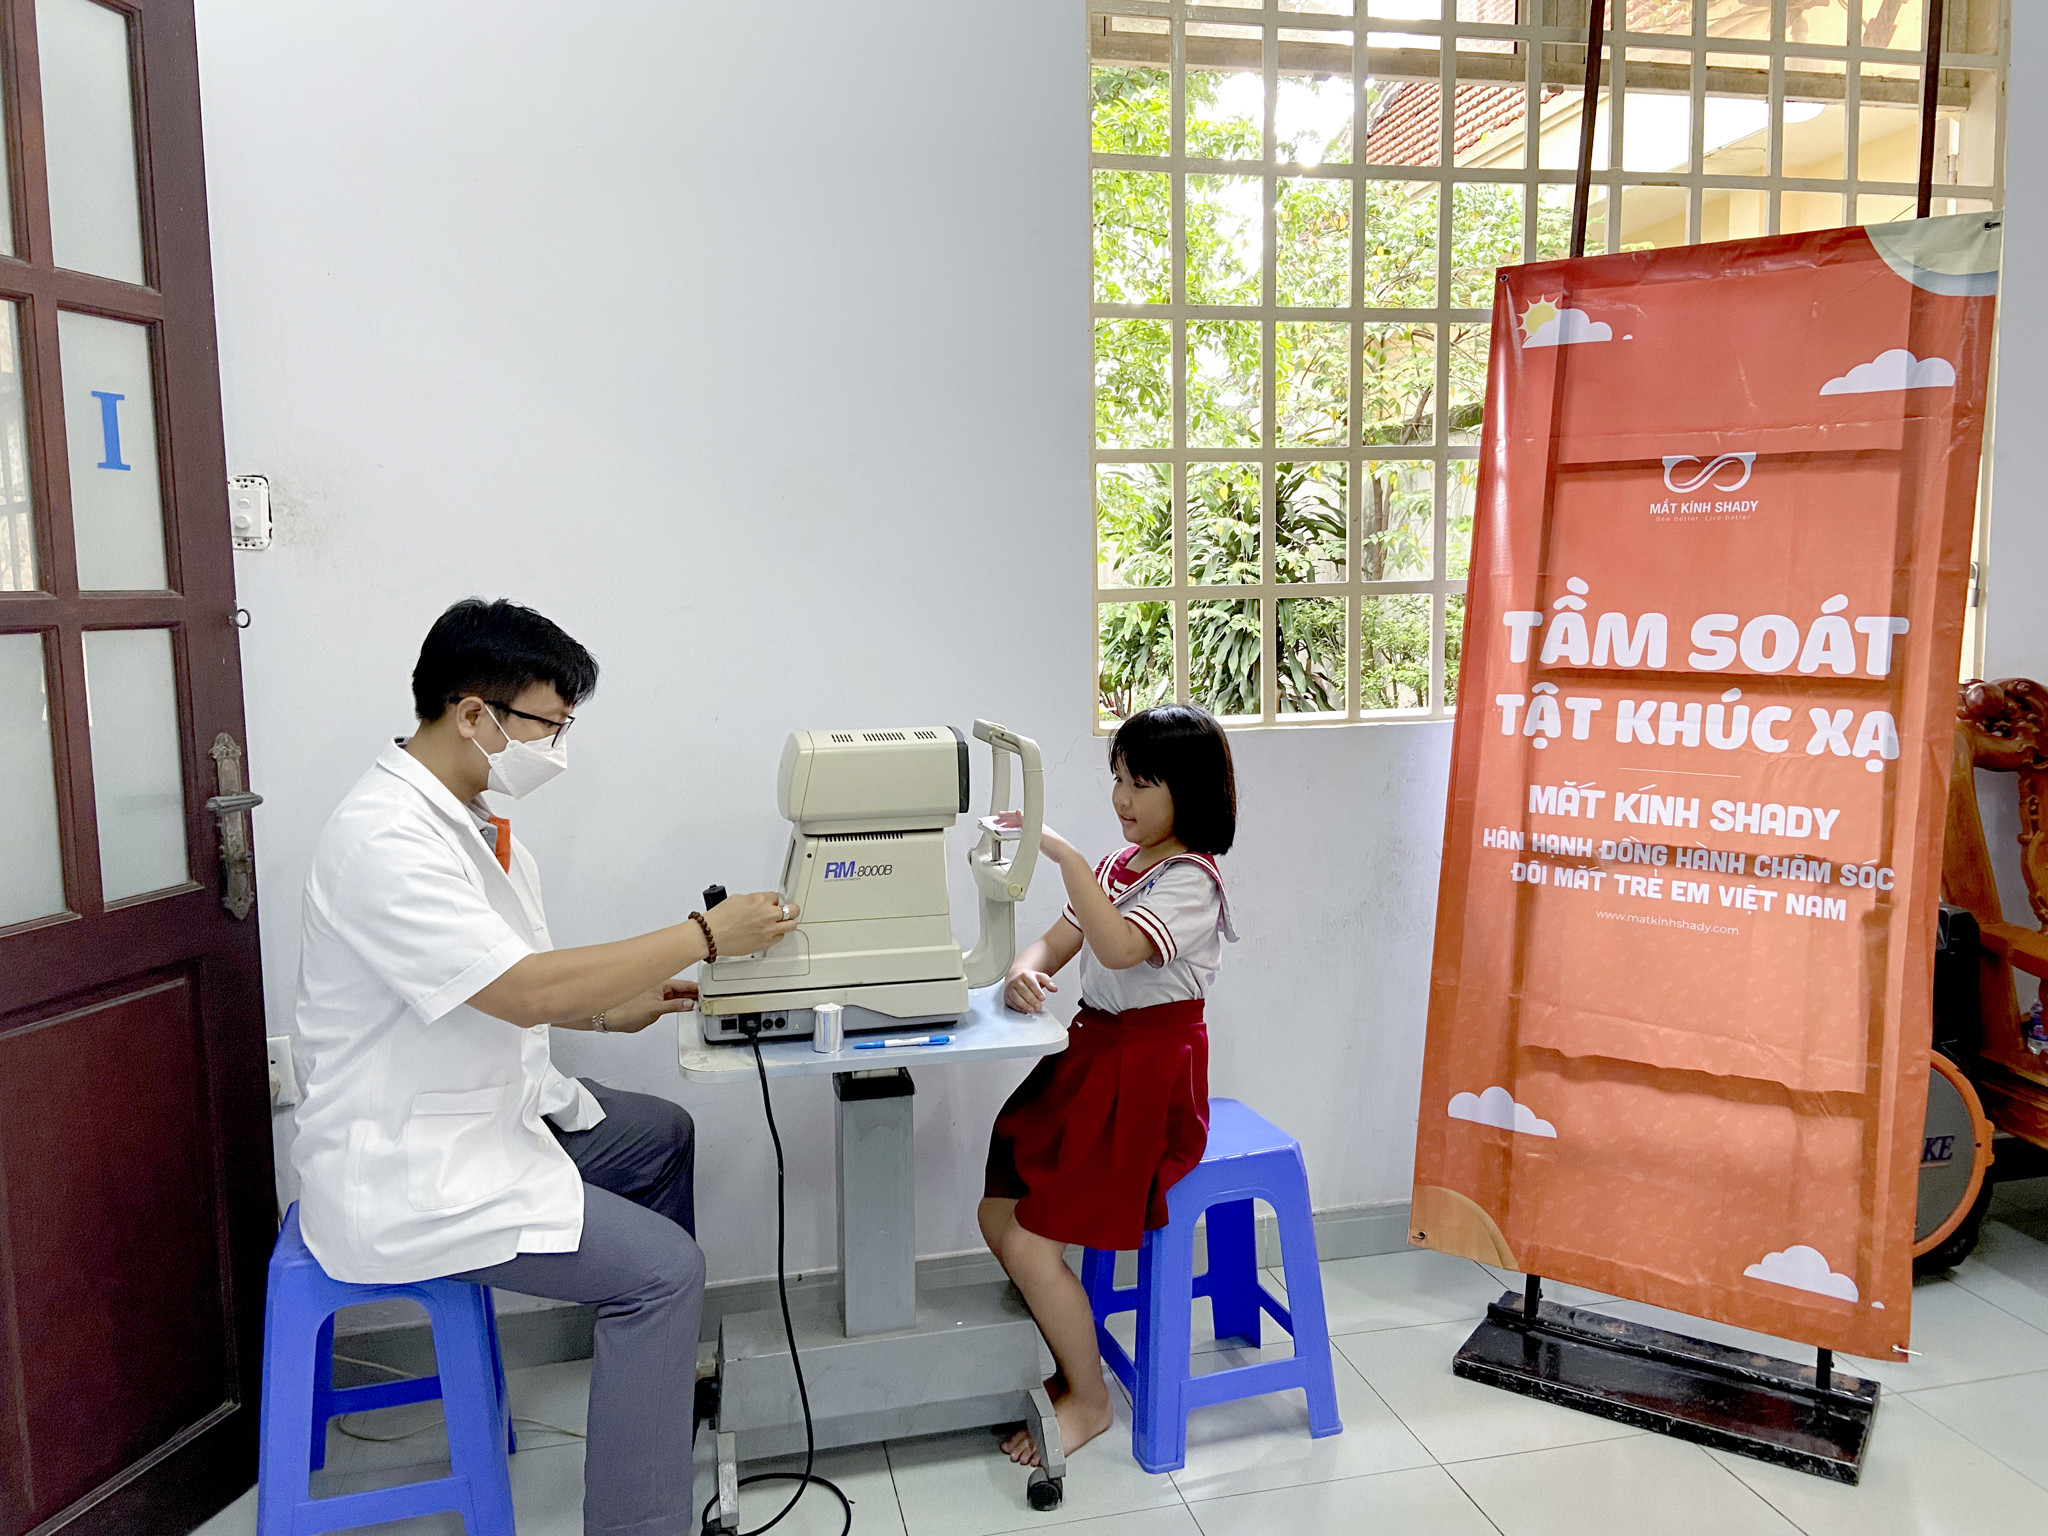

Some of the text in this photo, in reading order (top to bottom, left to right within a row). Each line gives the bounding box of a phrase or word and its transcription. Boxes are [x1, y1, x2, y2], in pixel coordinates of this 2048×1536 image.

[91, 390, 131, 471] I
[1649, 498, 1759, 515] MẮT KÍNH SHADY
[1502, 576, 1910, 676] TẦM SOÁT
[1495, 681, 1900, 773] TẬT KHÚC XẠ
[1528, 780, 1841, 841] MẮT KÍNH SHADY
[1483, 826, 1895, 891] HÂN HẠNH ĐỒNG HÀNH CHĂM SÓC
[1510, 860, 1847, 921] ĐÔI MẮT TRẺ EM VIỆT NAM
[1595, 910, 1740, 936] www.matkinhshady.com
